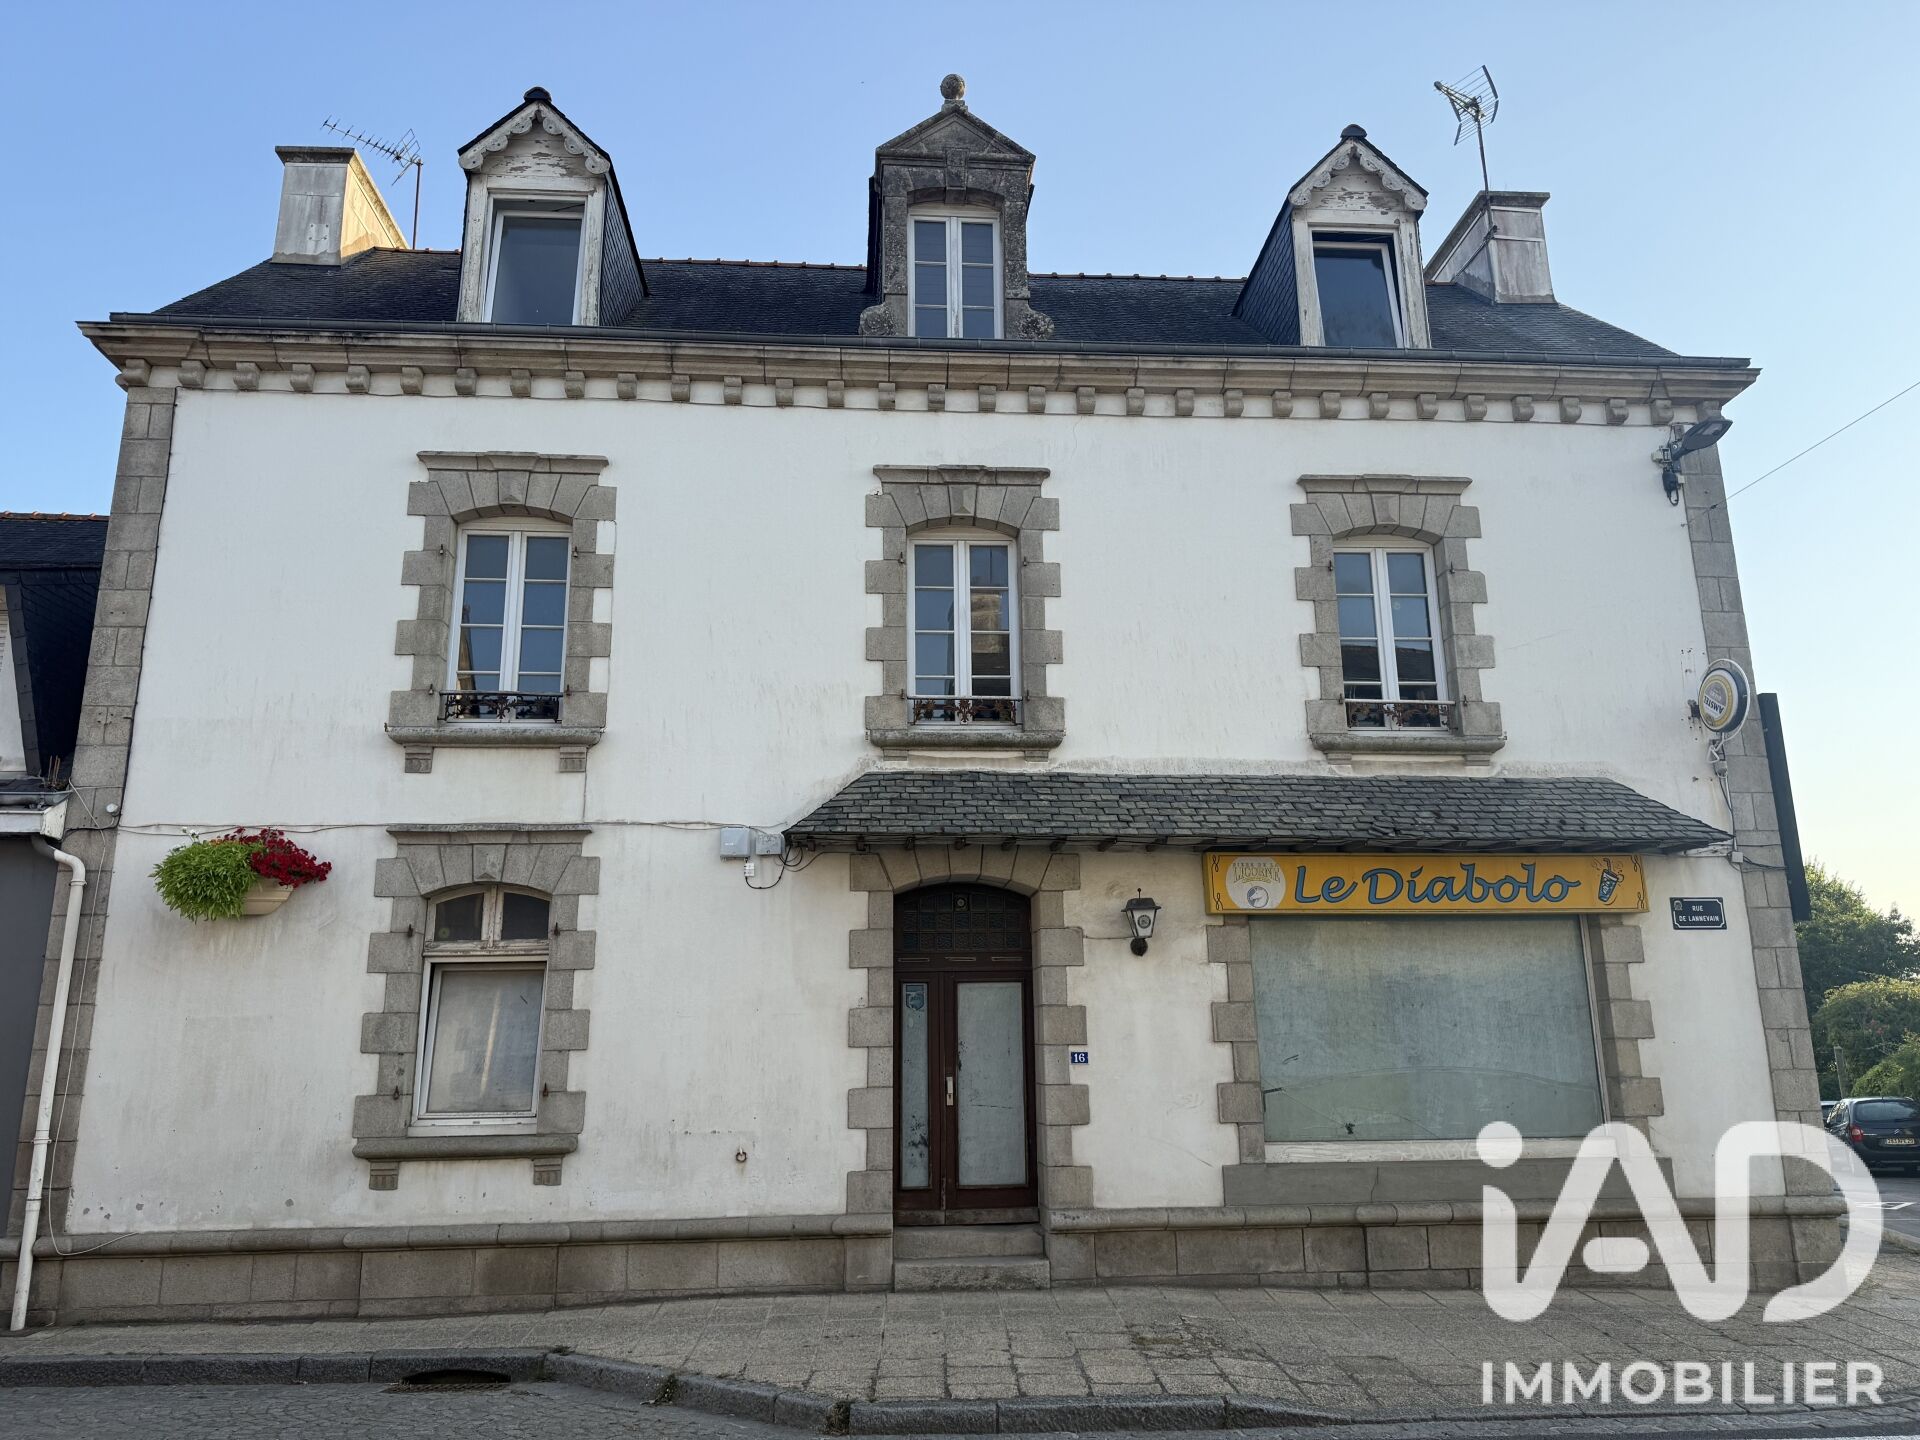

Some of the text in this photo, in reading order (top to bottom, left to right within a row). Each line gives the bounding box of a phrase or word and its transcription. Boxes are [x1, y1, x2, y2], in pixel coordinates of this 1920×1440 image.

[1703, 695, 1725, 715] AMSTEL
[1233, 867, 1280, 883] LICORNE
[1295, 866, 1358, 903] Le
[1362, 863, 1581, 904] Diabolo
[1074, 1053, 1085, 1062] 16
